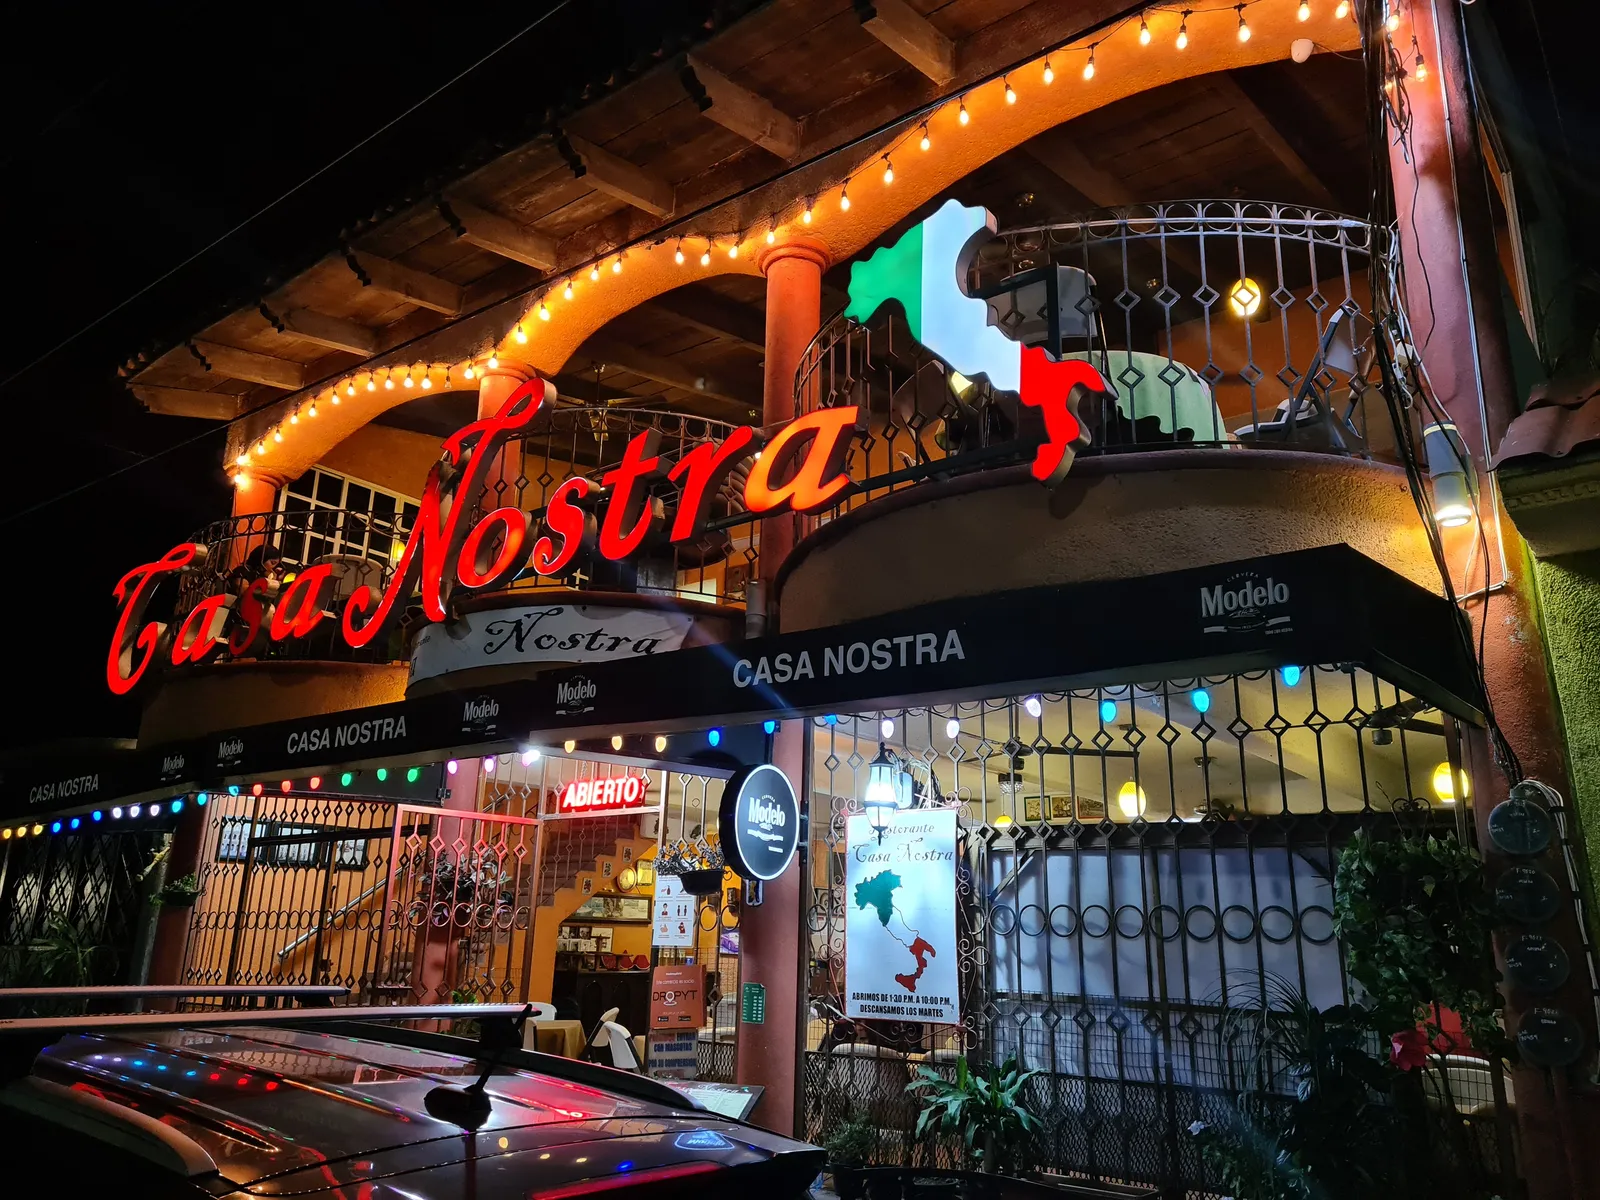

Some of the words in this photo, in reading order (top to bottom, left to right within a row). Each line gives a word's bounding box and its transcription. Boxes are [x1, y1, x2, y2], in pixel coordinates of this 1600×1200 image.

[107, 543, 340, 695] Casa
[343, 378, 862, 648] Nostra
[1200, 577, 1290, 618] Modelo
[483, 606, 662, 655] Nostra
[732, 650, 815, 688] CASA
[823, 629, 966, 677] NOSTRA
[556, 679, 597, 704] Modelo
[463, 699, 499, 722] Modelo
[287, 728, 330, 754] CASA
[334, 715, 407, 748] NOSTRA
[218, 739, 244, 759] Modelo
[162, 754, 185, 773] Modelo
[29, 783, 55, 804] CASA
[57, 773, 99, 798] NOSTRA
[562, 777, 639, 808] ABIERTO
[748, 797, 786, 827] Modelo
[869, 823, 935, 835] istorante
[852, 843, 891, 863] Casa
[897, 837, 954, 863] Nostra
[852, 992, 880, 1002] ABRIMOS
[881, 993, 888, 1002] DE
[903, 995, 915, 1004] P.M.
[916, 996, 921, 1004] A
[939, 997, 952, 1006] P.M.
[860, 1004, 905, 1015] DESCANSAMOS
[906, 1007, 917, 1016] LOS
[918, 1008, 944, 1018] MARTES
